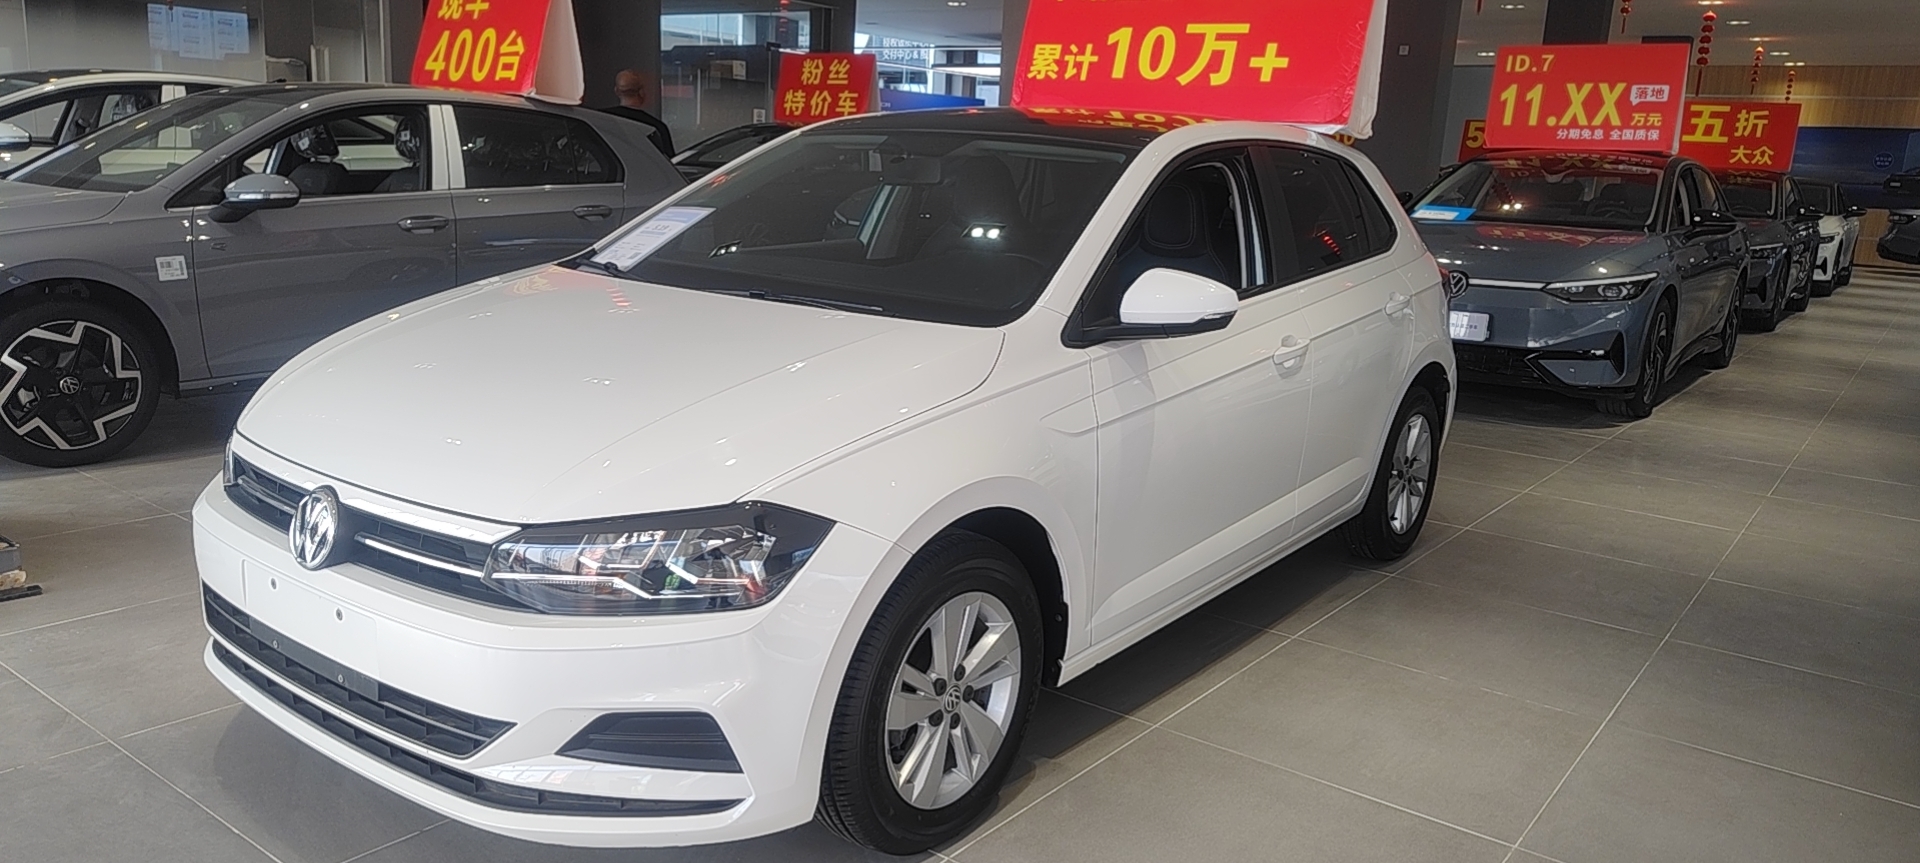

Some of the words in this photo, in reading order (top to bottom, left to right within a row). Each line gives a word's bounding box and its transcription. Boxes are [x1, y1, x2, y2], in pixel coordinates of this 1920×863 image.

[425, 28, 524, 82] 400台
[1506, 54, 1555, 72] ID.7
[801, 58, 850, 85] 粉丝
[784, 89, 858, 116] 特价车
[1500, 83, 1627, 126] 11.XX
[1634, 87, 1665, 100] 落地
[1631, 113, 1662, 126] 万元
[1682, 105, 1769, 143] 五折
[1556, 128, 1604, 140] 分期免息
[1609, 129, 1660, 140] 全国质保
[1729, 145, 1774, 165] 大众
